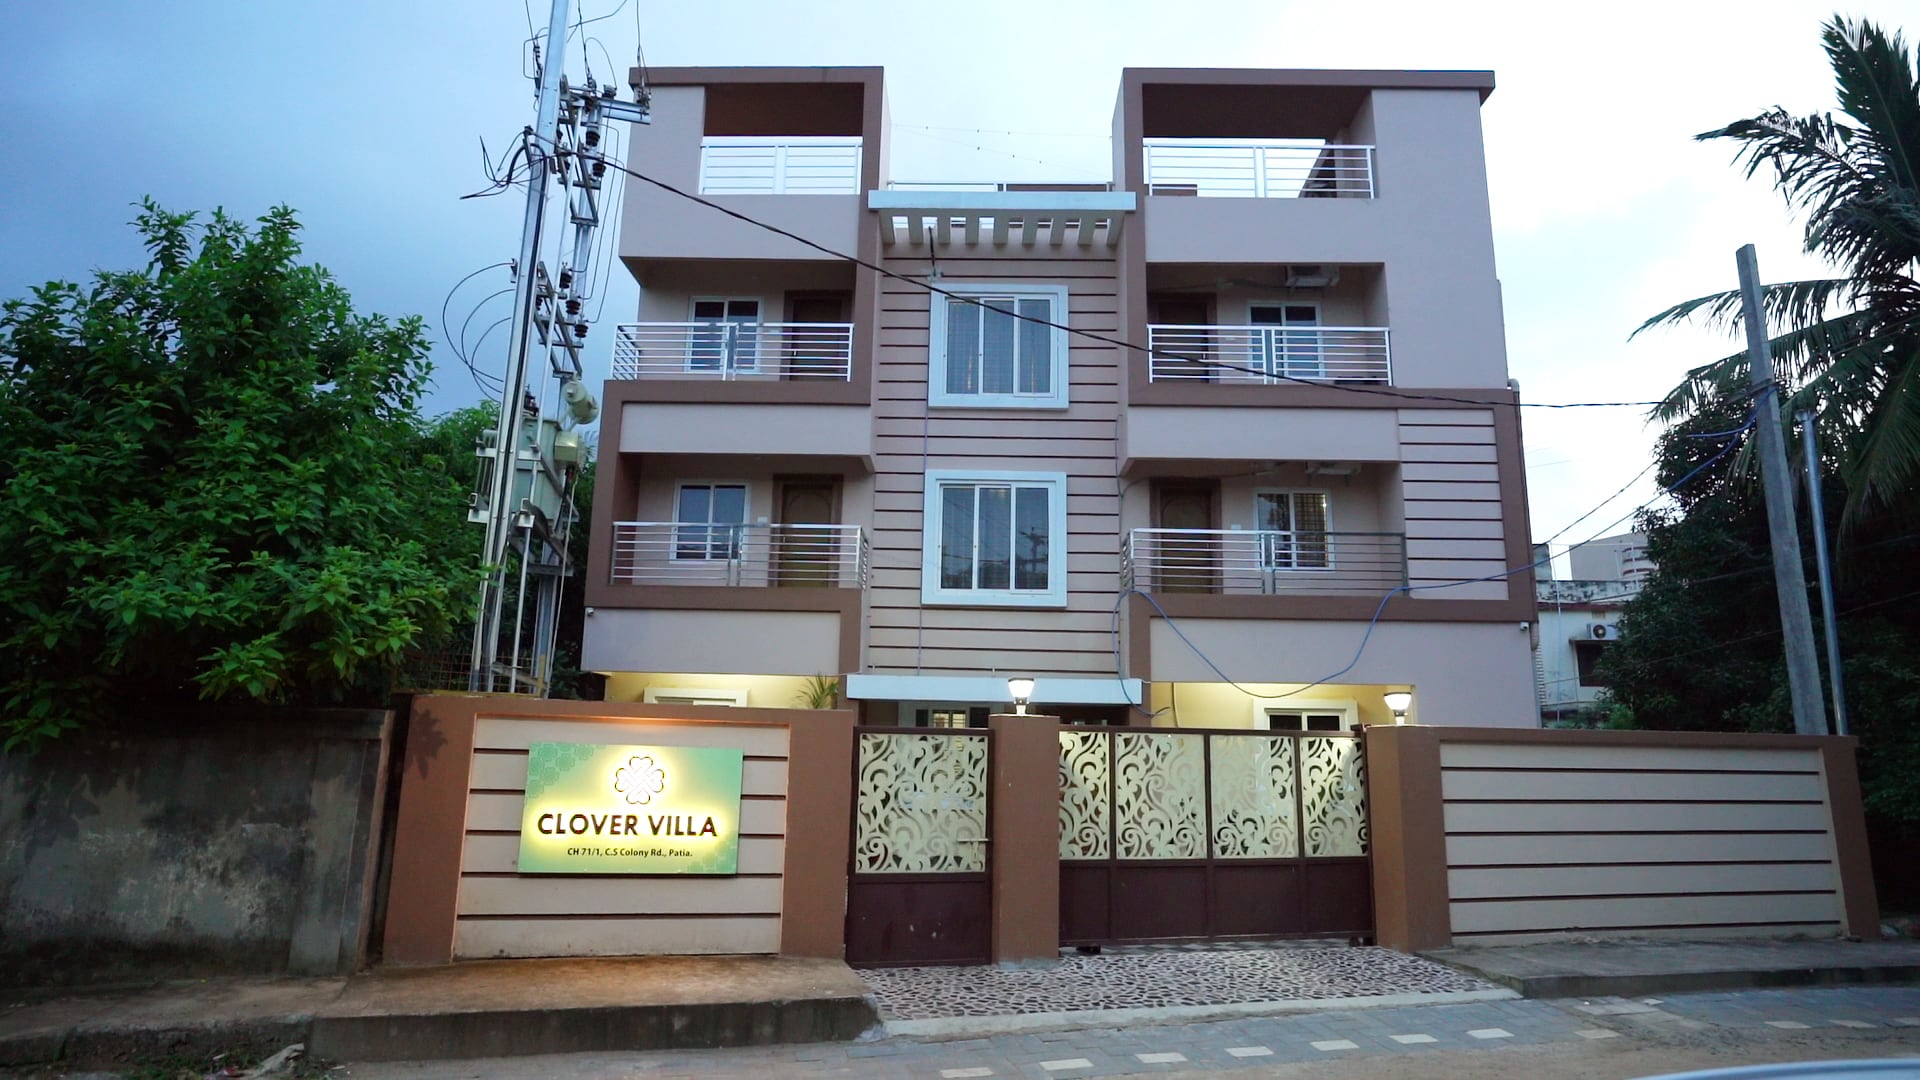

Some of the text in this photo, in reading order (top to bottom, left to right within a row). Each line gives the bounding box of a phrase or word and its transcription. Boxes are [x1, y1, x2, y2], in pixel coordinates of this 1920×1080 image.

[537, 813, 717, 837] CLOVER VILLA
[567, 847, 580, 856] CH
[581, 848, 603, 857] 71/1,
[619, 848, 649, 858] Colony
[668, 849, 693, 857] Patia.
